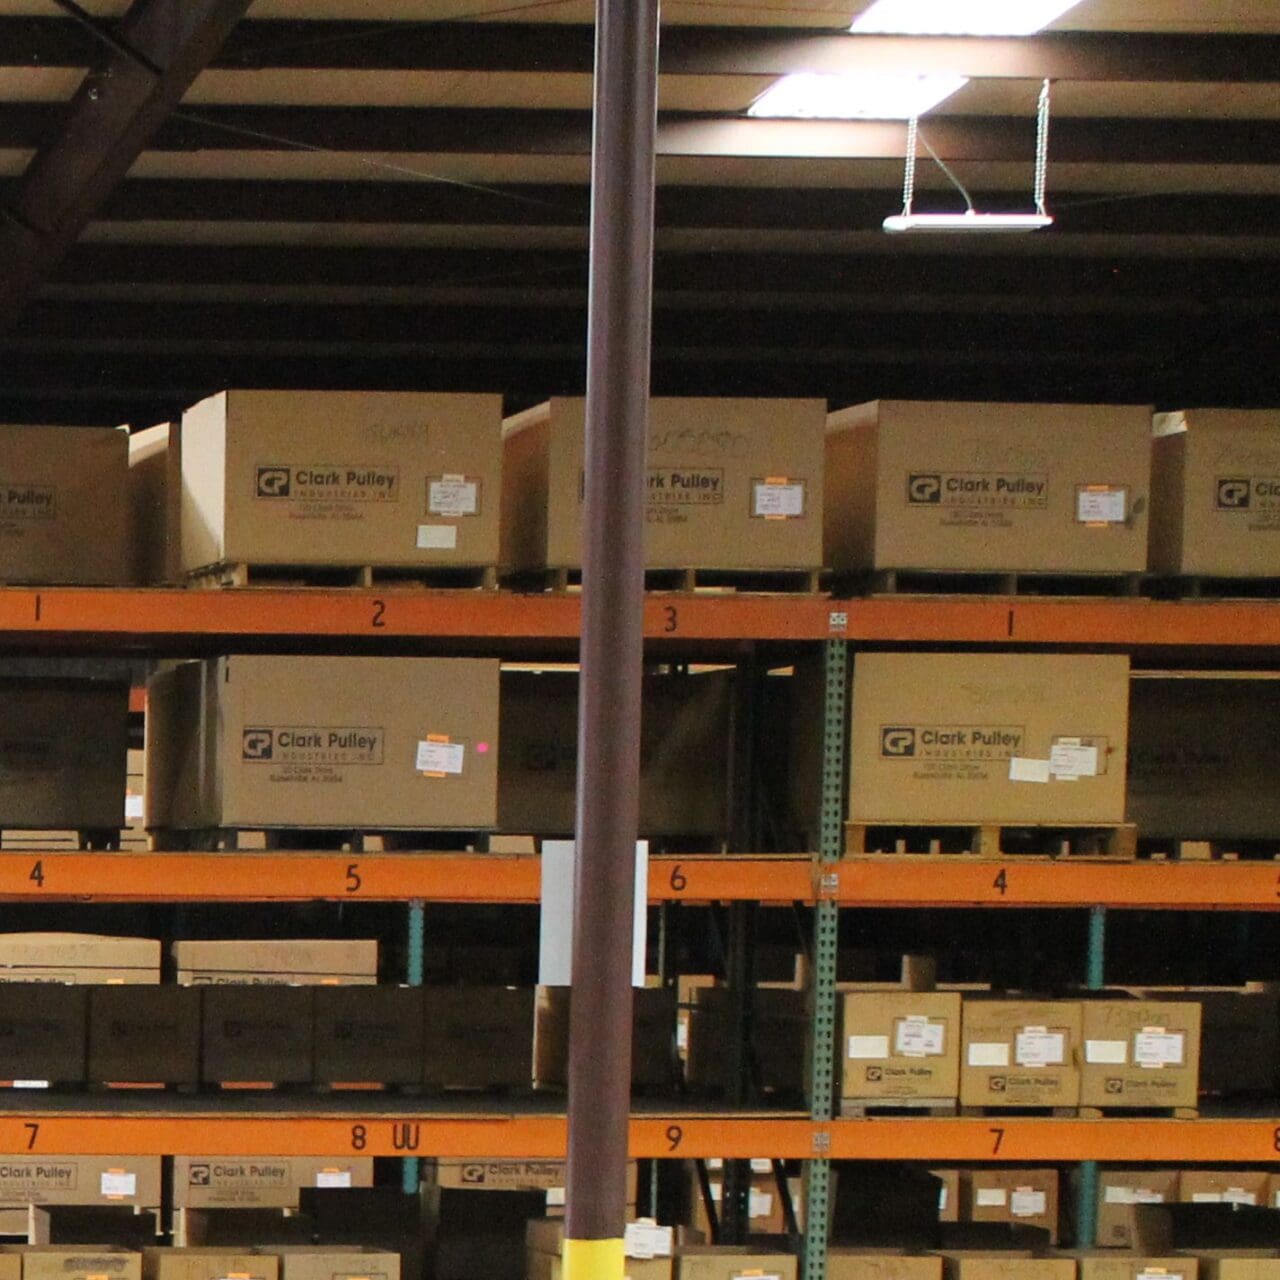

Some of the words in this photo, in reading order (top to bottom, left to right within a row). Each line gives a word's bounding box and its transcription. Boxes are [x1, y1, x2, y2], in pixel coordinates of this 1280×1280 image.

[295, 469, 340, 486] Clark
[346, 470, 397, 489] Pulley
[672, 473, 720, 491] Pulley
[945, 476, 990, 493] Clark
[996, 477, 1046, 496] Pulley
[35, 593, 42, 622] 1
[372, 599, 386, 628] 2
[664, 605, 678, 633] 3
[1007, 610, 1014, 637] 1
[278, 731, 322, 748] Clark
[328, 732, 377, 752] Pulley
[920, 730, 966, 744] Clark
[972, 730, 1022, 746] Pulley
[29, 860, 45, 887] 4
[346, 863, 362, 893] 5
[670, 864, 687, 892] 6
[993, 868, 1008, 895] 4
[24, 1122, 40, 1150] 7
[351, 1124, 367, 1151] 8
[666, 1125, 683, 1151] 9
[989, 1128, 1005, 1154] 7
[0, 1166, 32, 1178] Clark
[36, 1166, 71, 1179] Pulley
[214, 1165, 246, 1177] Clark
[250, 1165, 285, 1179] Pulley
